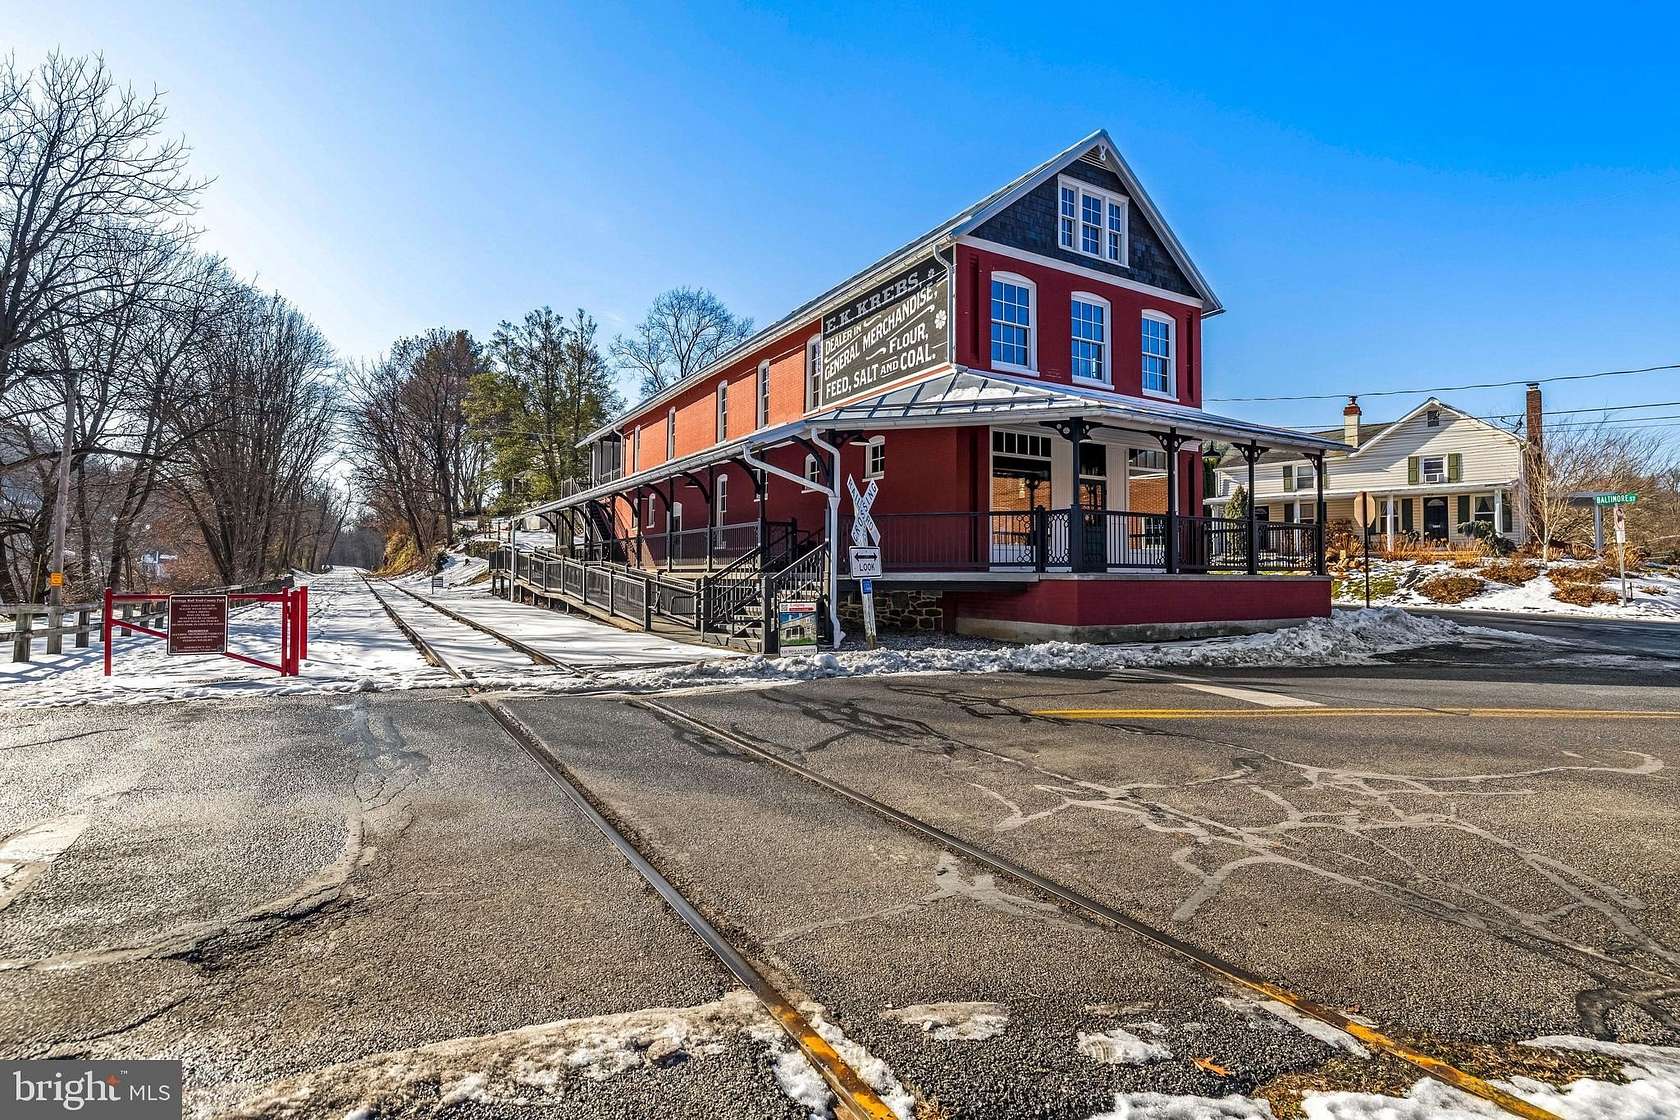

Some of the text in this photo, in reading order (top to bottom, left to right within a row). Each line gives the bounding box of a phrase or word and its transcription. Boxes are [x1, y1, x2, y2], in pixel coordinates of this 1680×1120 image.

[856, 271, 919, 316] KREBS
[824, 281, 938, 381] GENERAL MERCHANDISE,
[825, 324, 862, 355] DEALER IN
[889, 322, 929, 354] FLOUR,
[825, 343, 936, 400] FEED, SALT AND COAL.
[852, 482, 877, 542] CROSSING
[1596, 495, 1630, 504] BALTIMORE
[859, 563, 876, 572] LOOK
